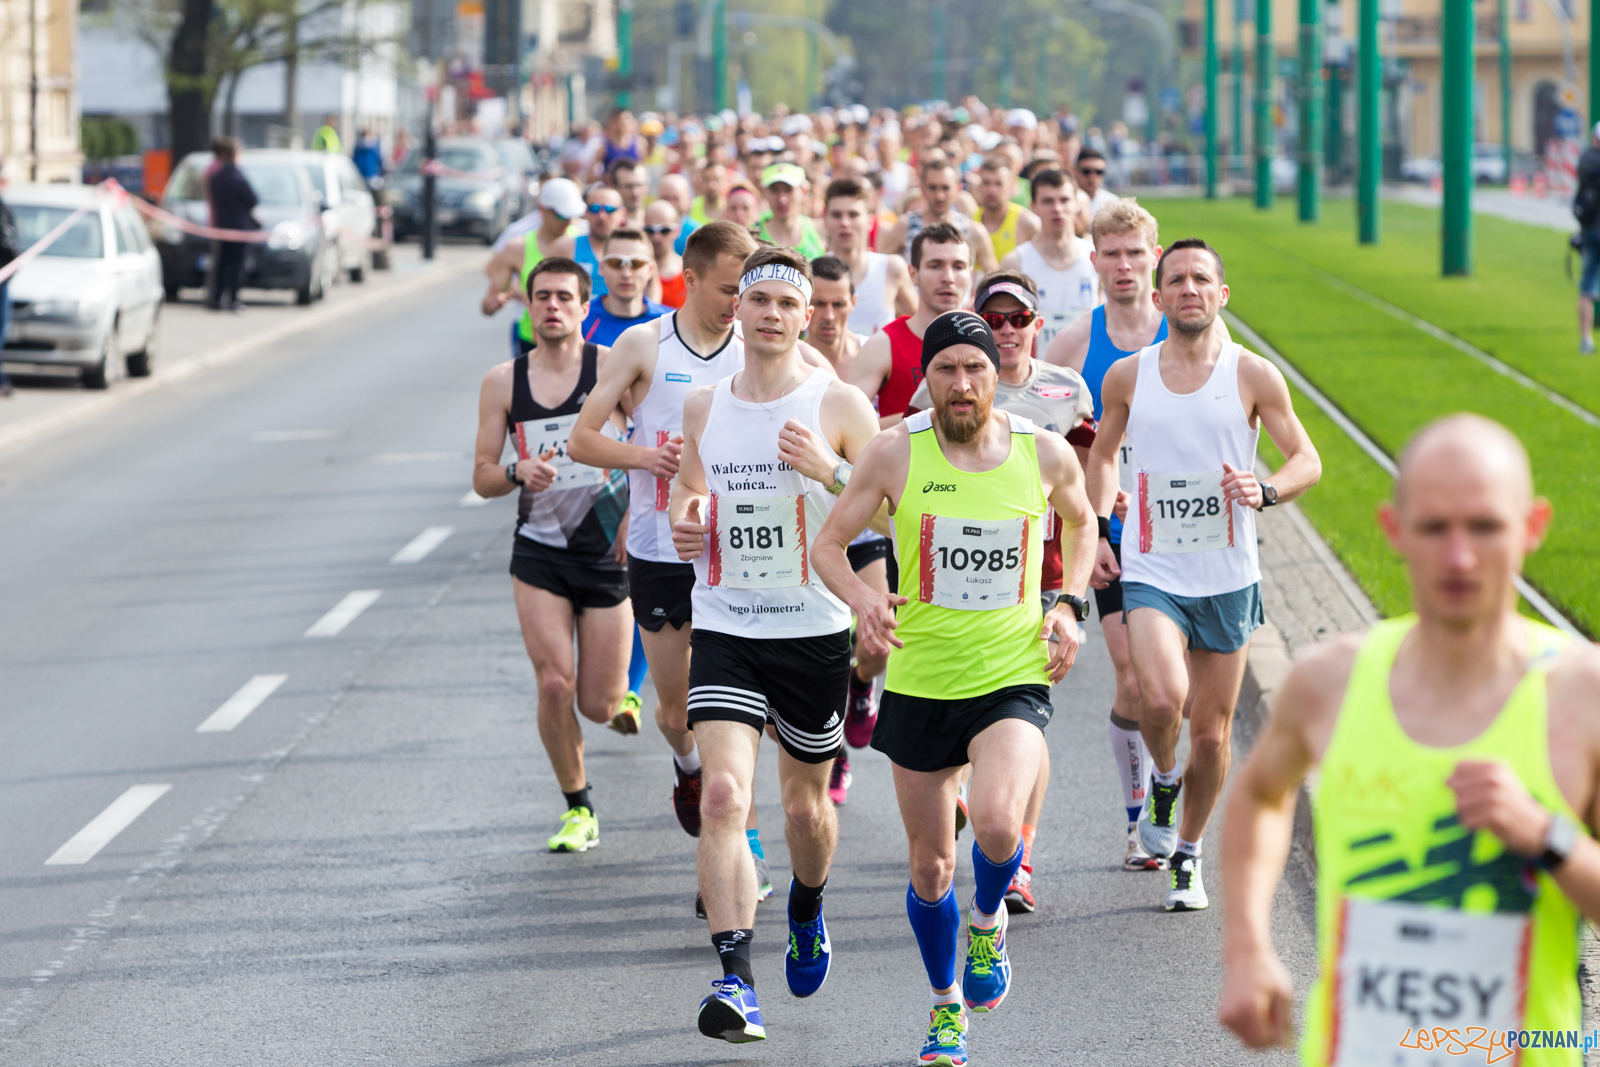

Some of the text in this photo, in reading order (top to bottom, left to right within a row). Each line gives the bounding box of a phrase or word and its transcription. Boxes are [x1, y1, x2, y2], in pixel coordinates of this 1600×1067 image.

[767, 263, 803, 288] JEZUS
[1120, 446, 1132, 464] 1
[711, 461, 794, 476] Walczymy do
[728, 479, 777, 491] końca...
[1156, 496, 1220, 519] 11928
[730, 526, 784, 549] 8181
[740, 554, 773, 562] Zbigniew
[938, 547, 1019, 572] 10985
[966, 576, 992, 584] Łukasz
[729, 602, 805, 615] tego kilometra!
[1356, 964, 1503, 1027] KĘSY
